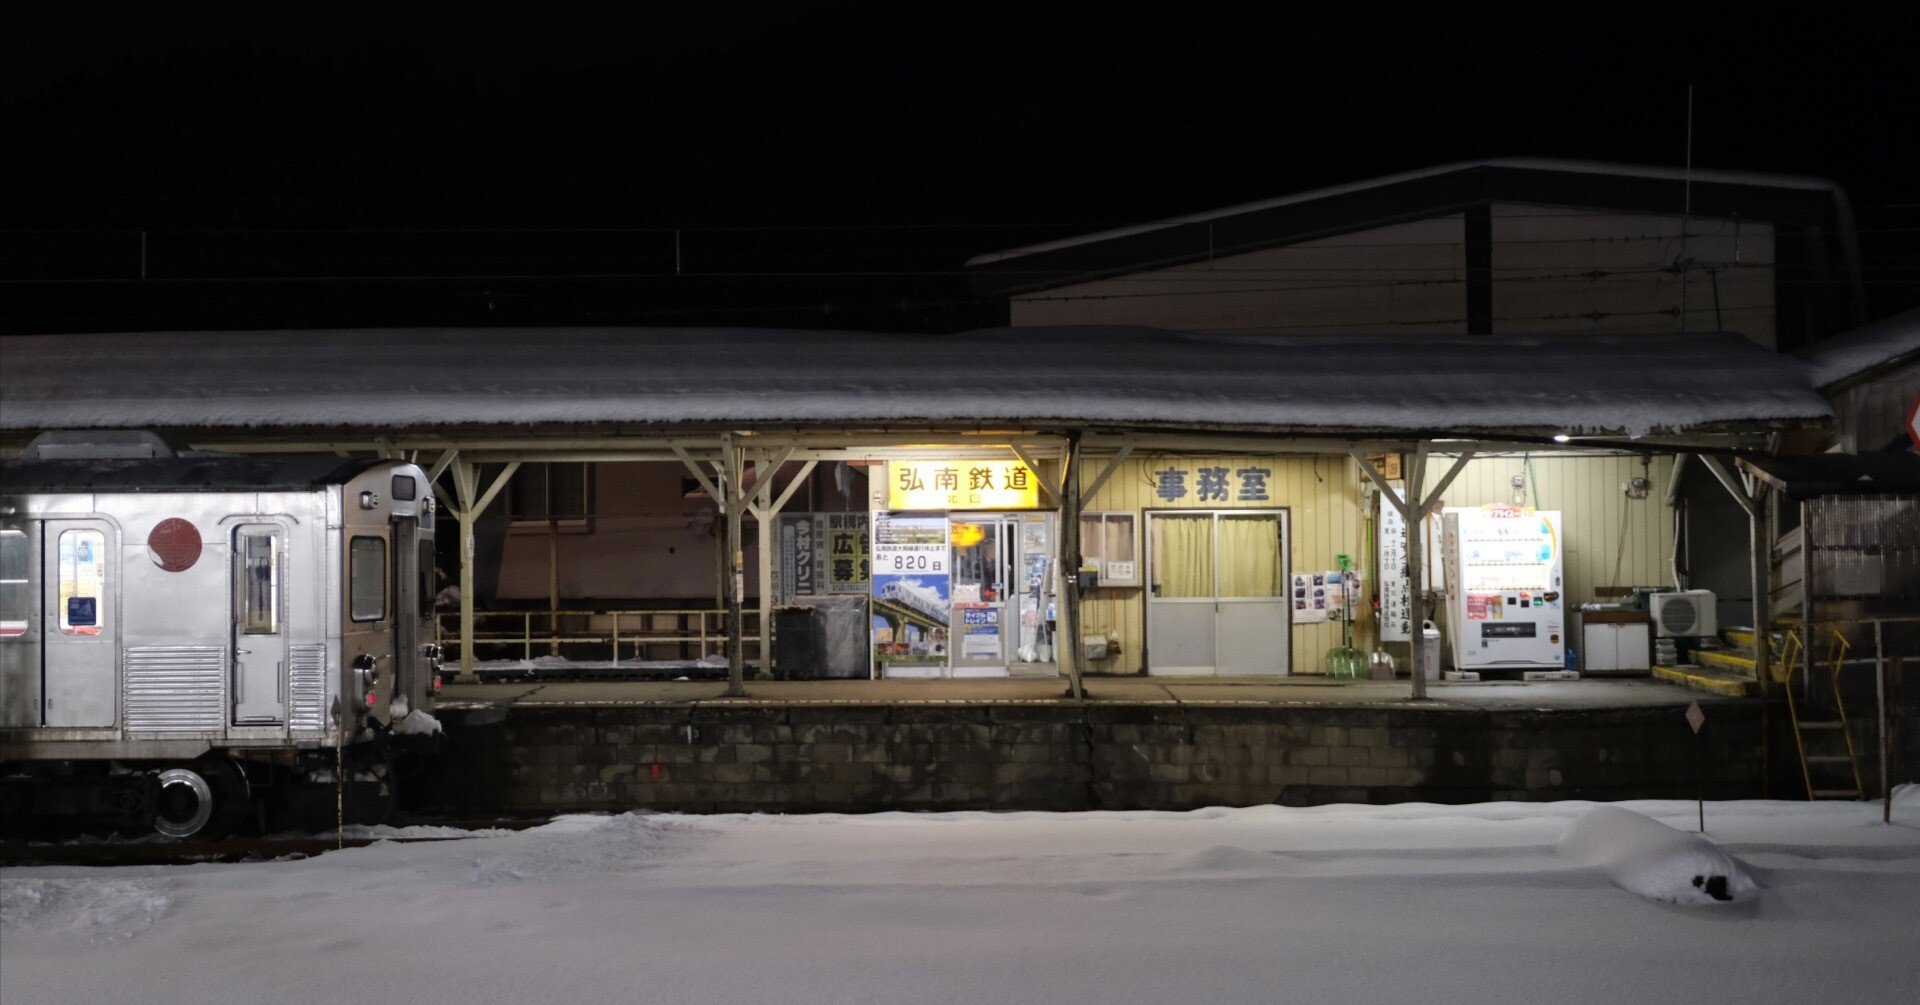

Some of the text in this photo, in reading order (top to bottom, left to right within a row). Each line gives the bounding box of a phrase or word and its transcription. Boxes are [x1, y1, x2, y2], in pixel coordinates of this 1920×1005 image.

[899, 466, 1029, 491] 弘南鉄道
[1154, 466, 1271, 502] 事務室
[875, 553, 941, 571] あと 820 日
